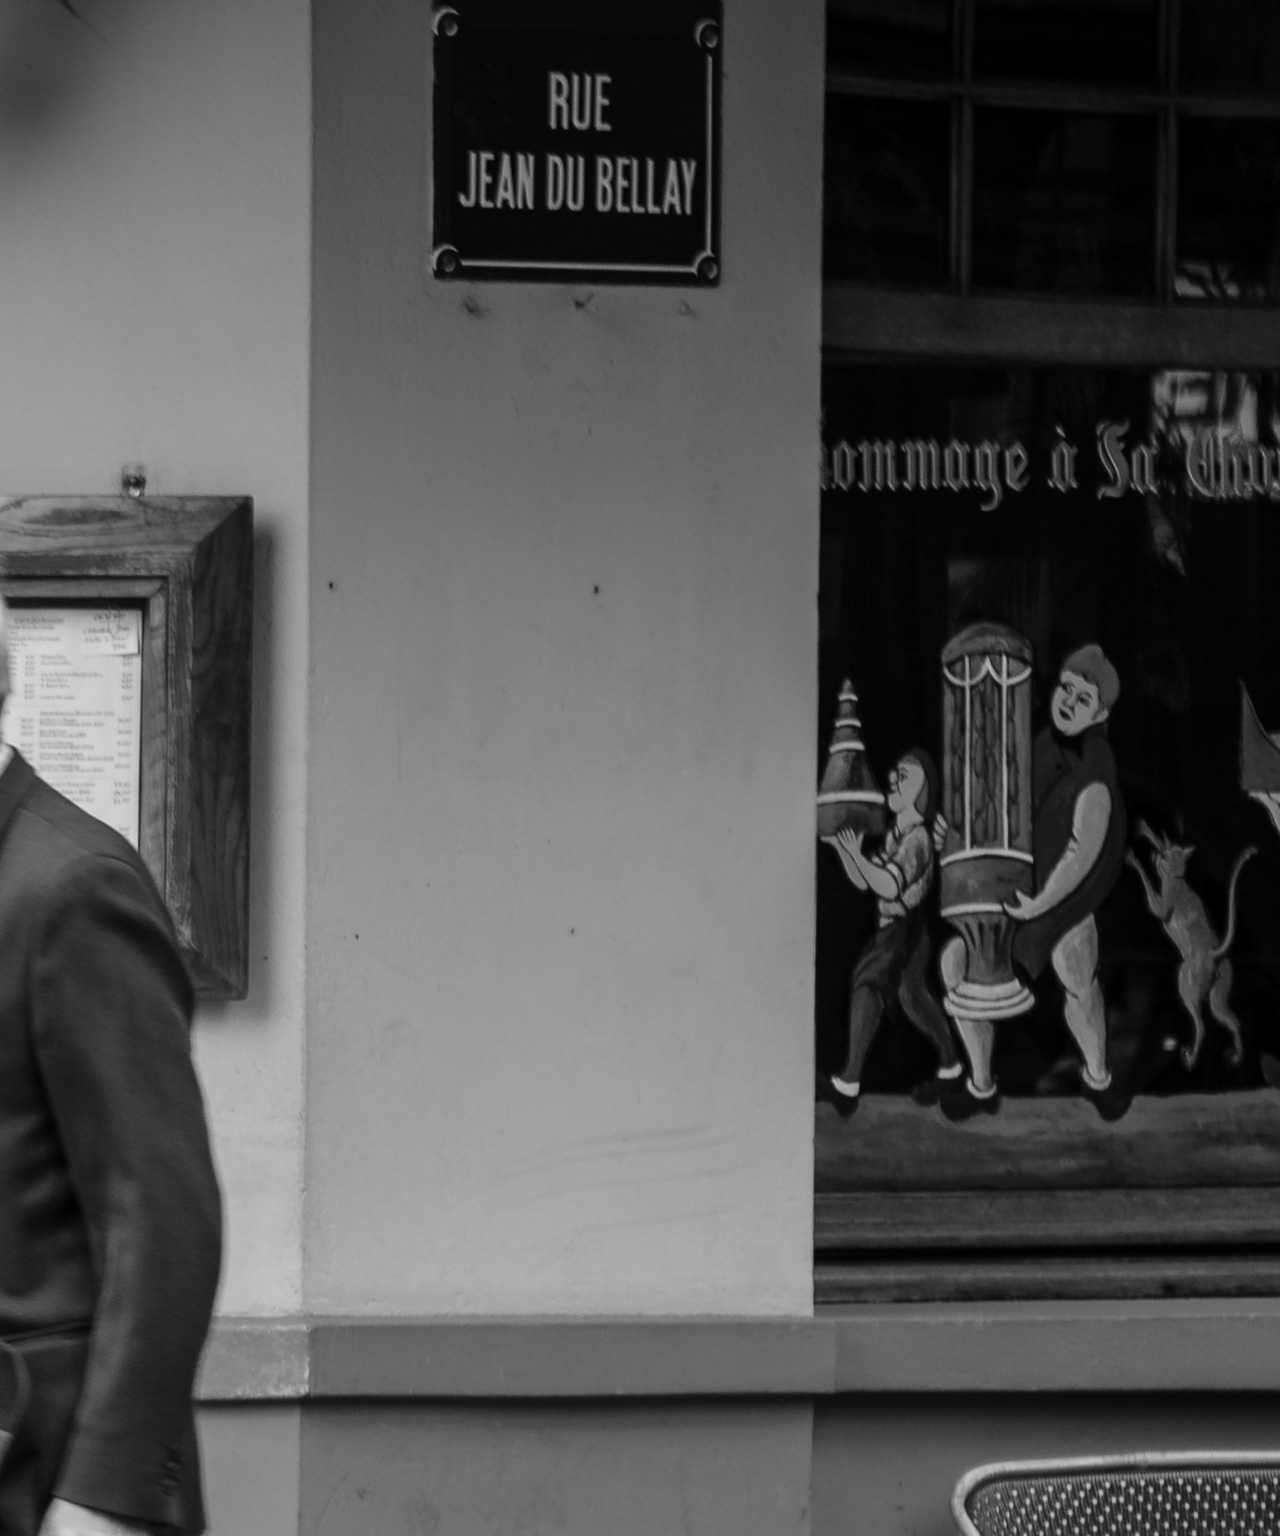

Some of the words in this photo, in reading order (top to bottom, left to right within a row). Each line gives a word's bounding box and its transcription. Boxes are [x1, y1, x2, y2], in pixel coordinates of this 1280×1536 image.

[548, 71, 612, 132] RUE
[458, 151, 535, 211] JEAN
[546, 154, 586, 212] DU
[595, 155, 697, 216] BELLAY
[821, 437, 1032, 512] ommage
[1047, 423, 1080, 494] à
